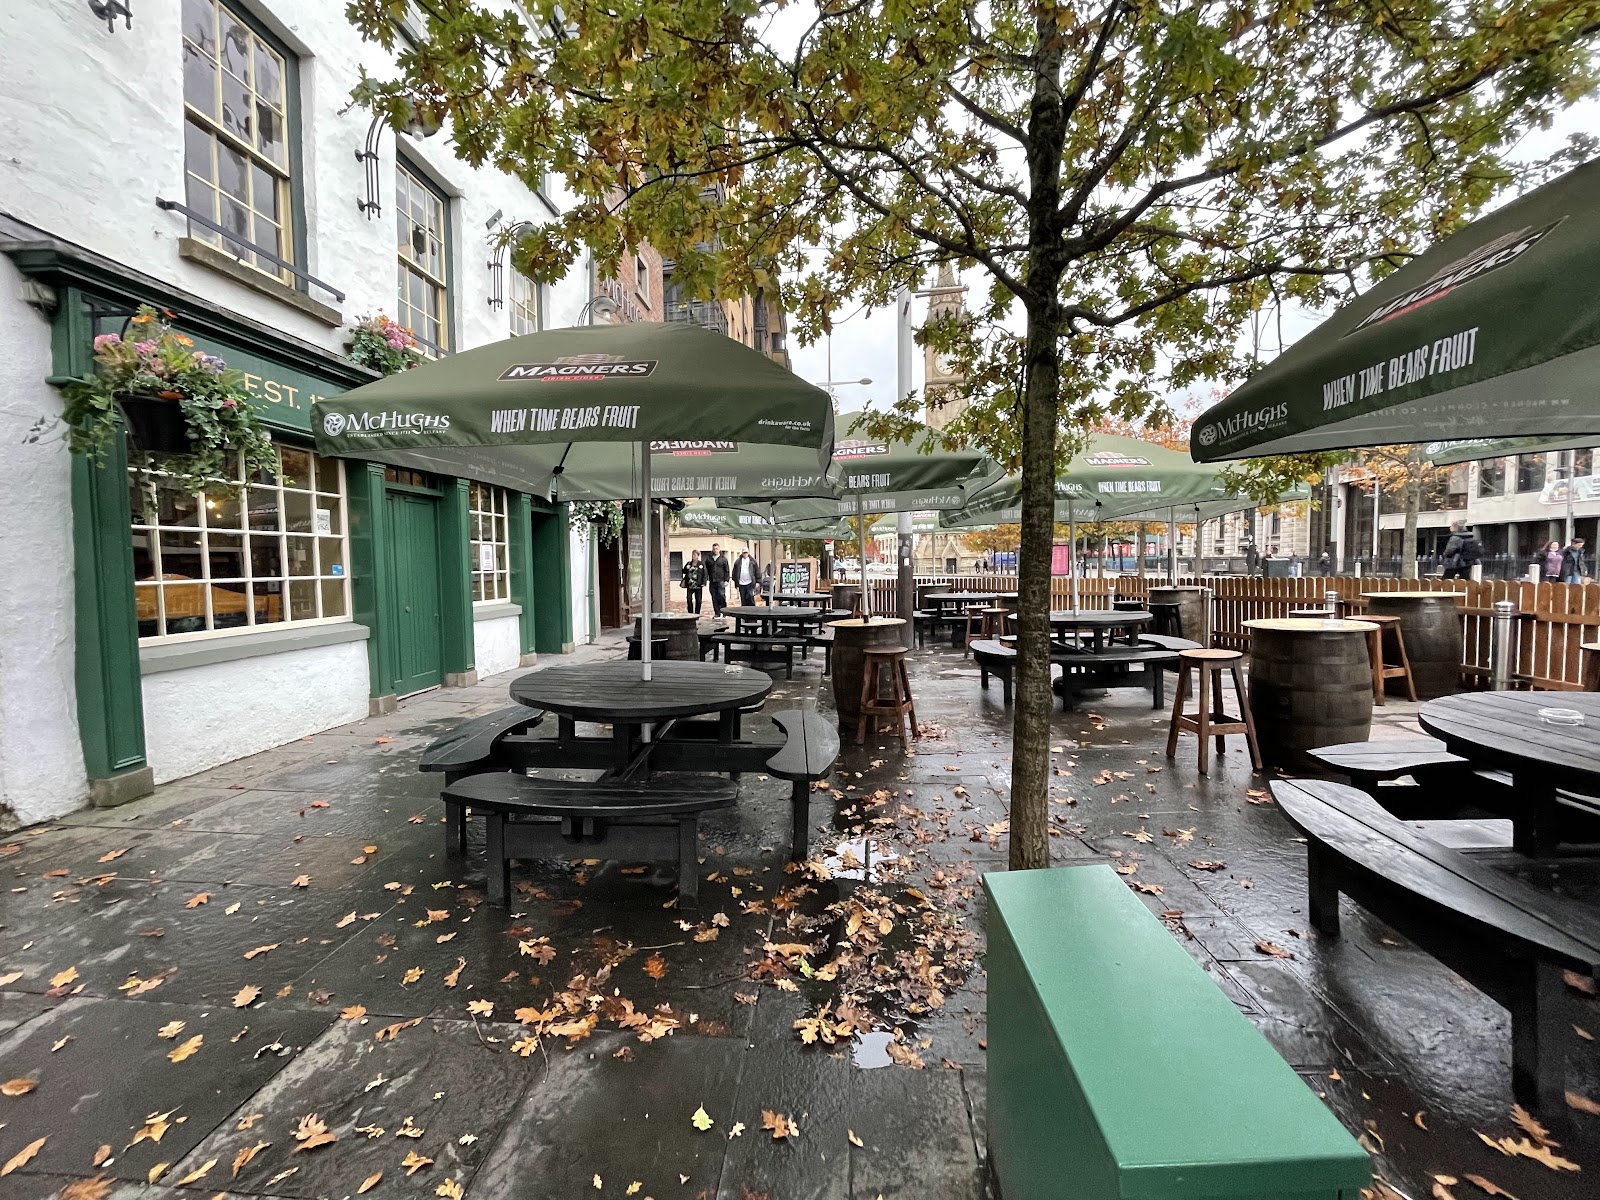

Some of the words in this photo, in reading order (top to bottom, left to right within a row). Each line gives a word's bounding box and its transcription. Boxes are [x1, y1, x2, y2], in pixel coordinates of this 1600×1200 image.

[1355, 232, 1544, 329] MAGNERS
[508, 363, 649, 377] MAGNERS
[1323, 373, 1355, 411] WHEN
[1358, 361, 1386, 400] TIME
[1387, 345, 1429, 391] BEARS
[1428, 327, 1479, 375] FRUIT
[244, 373, 301, 410] EST.
[491, 408, 527, 433] WHEN
[530, 408, 560, 432] TIME
[560, 406, 601, 430] BEARS
[601, 405, 641, 429] FRUIT
[758, 419, 811, 427] drinkaware.co.uk
[848, 475, 870, 488] BEARS
[871, 473, 891, 488] FRUIT
[1098, 482, 1114, 493] WHEN
[1114, 481, 1128, 493] TIME
[1127, 481, 1146, 492] BEARS
[1146, 480, 1161, 492] FRUIT
